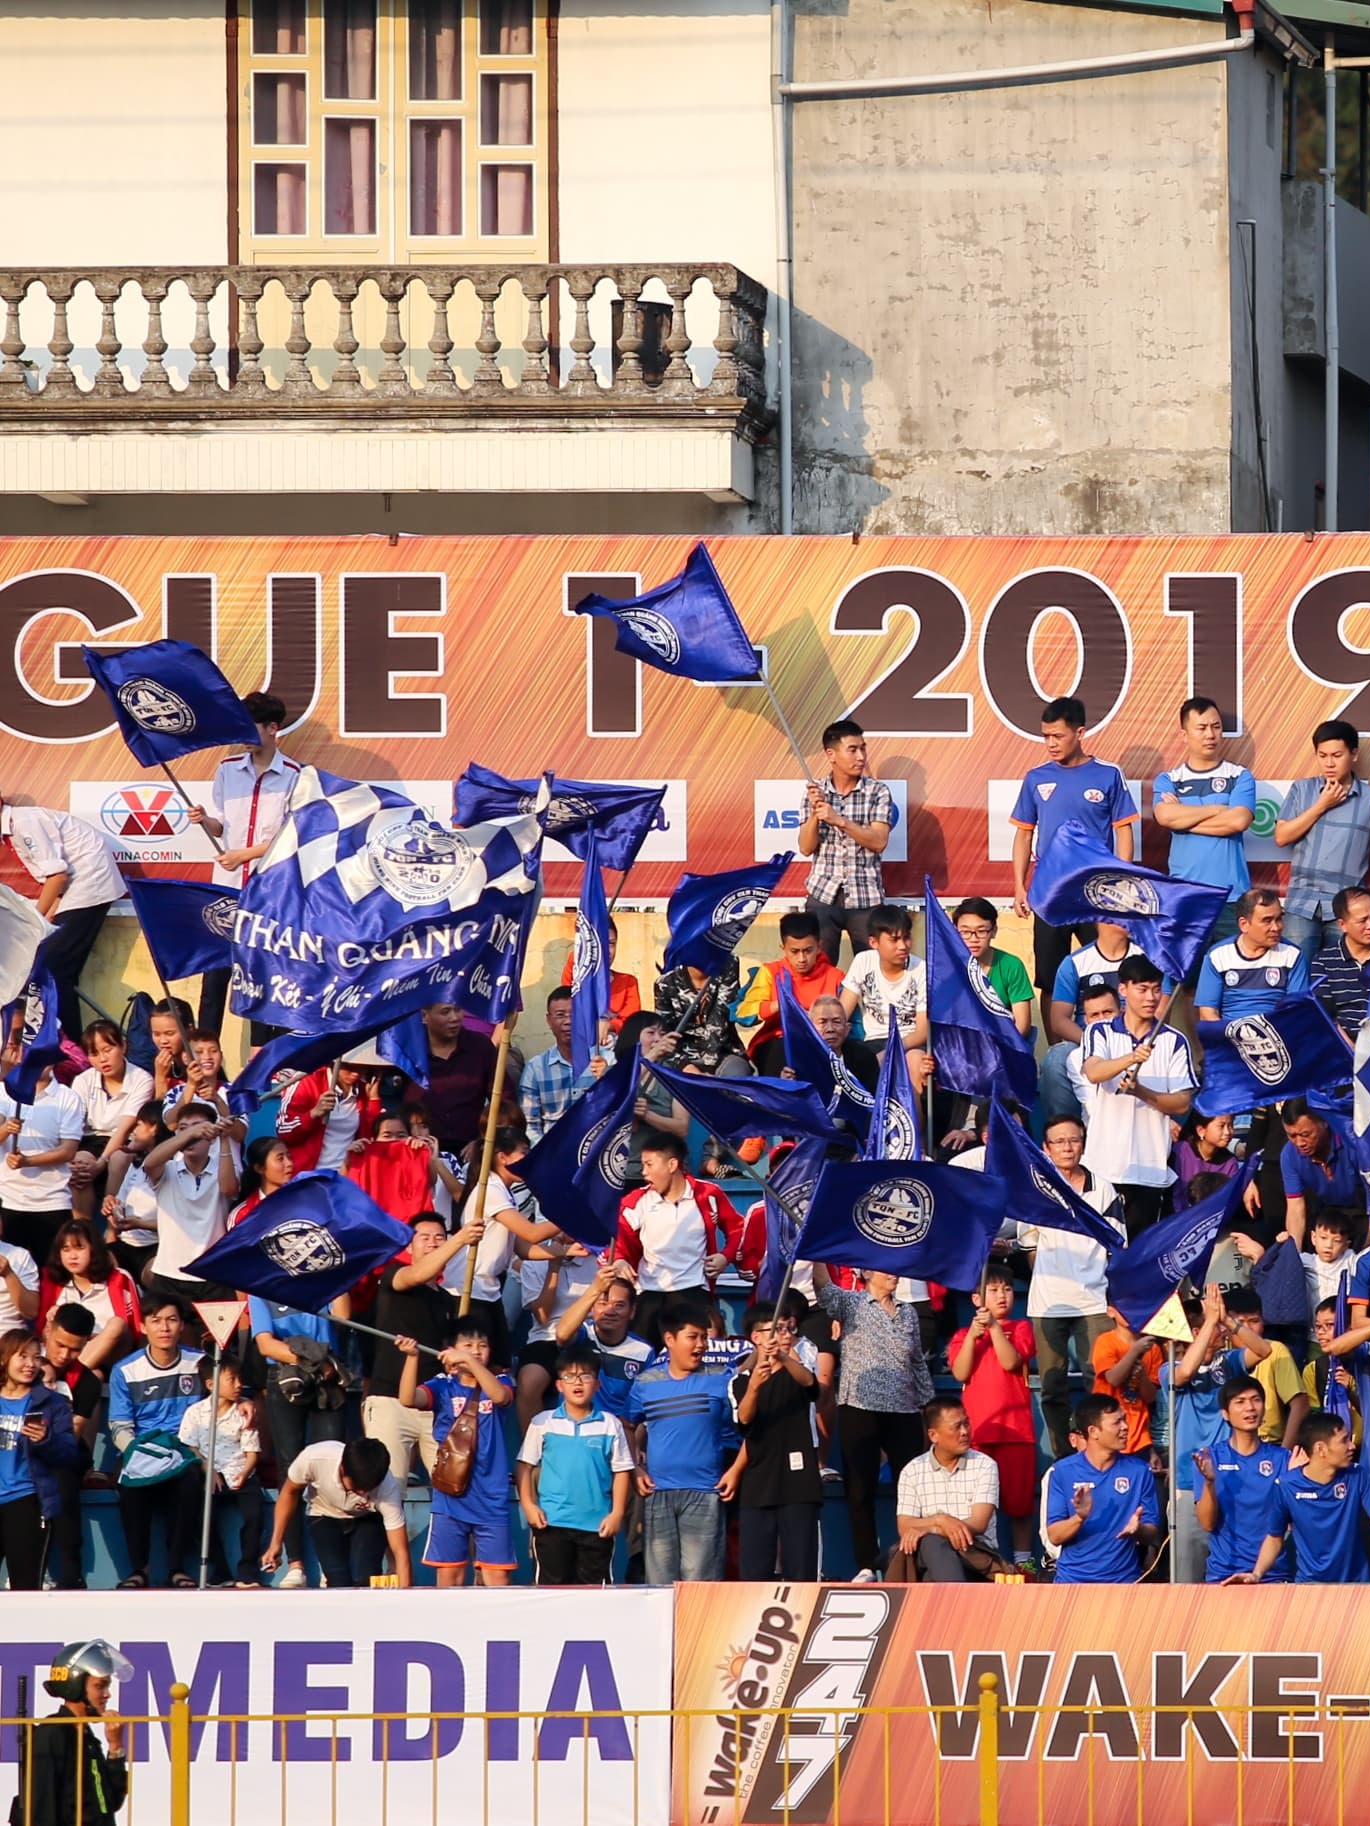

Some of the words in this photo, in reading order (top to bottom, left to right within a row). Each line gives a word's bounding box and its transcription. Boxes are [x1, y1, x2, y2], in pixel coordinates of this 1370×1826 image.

[112, 851, 183, 861] VINACOMIN
[232, 909, 325, 964] THAN
[337, 920, 481, 968] QUẢNG
[270, 974, 303, 1009] Kết
[872, 1202, 896, 1214] TQN
[119, 1640, 634, 1763] MEDIA
